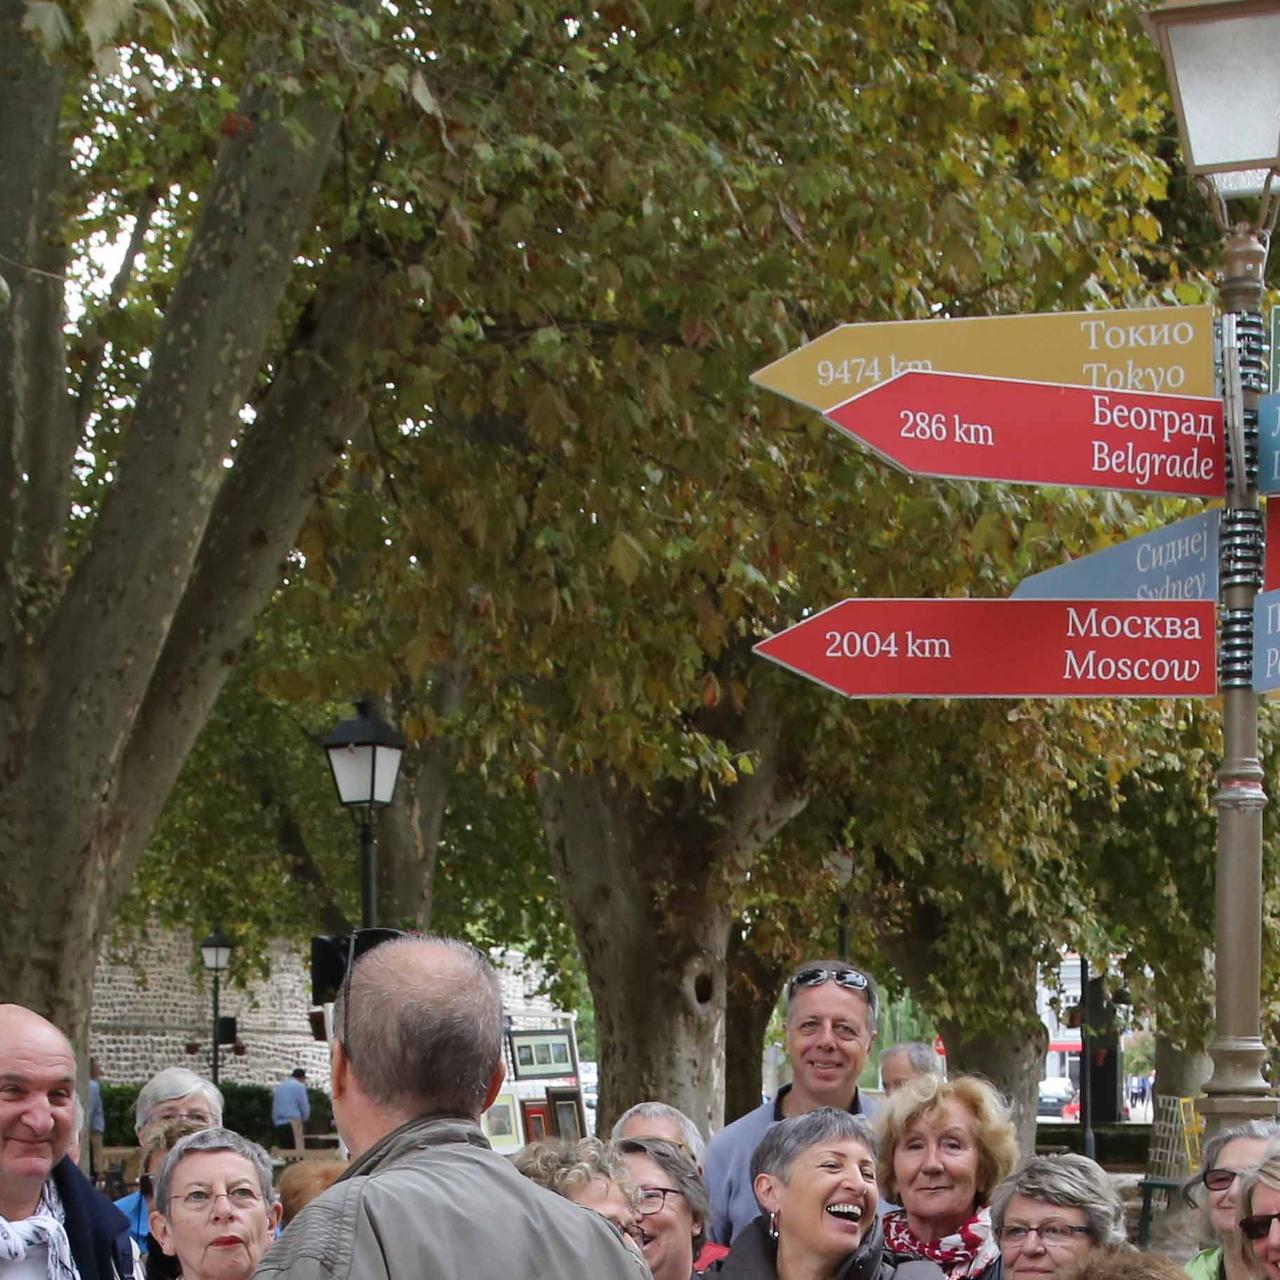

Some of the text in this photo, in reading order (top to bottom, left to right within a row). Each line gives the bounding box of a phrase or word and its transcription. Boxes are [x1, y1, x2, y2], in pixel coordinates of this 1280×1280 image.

[1080, 320, 1194, 350] Токио
[817, 357, 881, 386] 9474
[1082, 360, 1185, 393] Tokyo
[899, 410, 995, 446] 286 km
[1091, 395, 1216, 444] Београд
[1091, 440, 1215, 485] Belgrade
[1136, 521, 1208, 573] Сиднеј
[1065, 607, 1202, 639] Москва
[825, 631, 952, 659] 2004 km
[1062, 650, 1201, 681] Moscow
